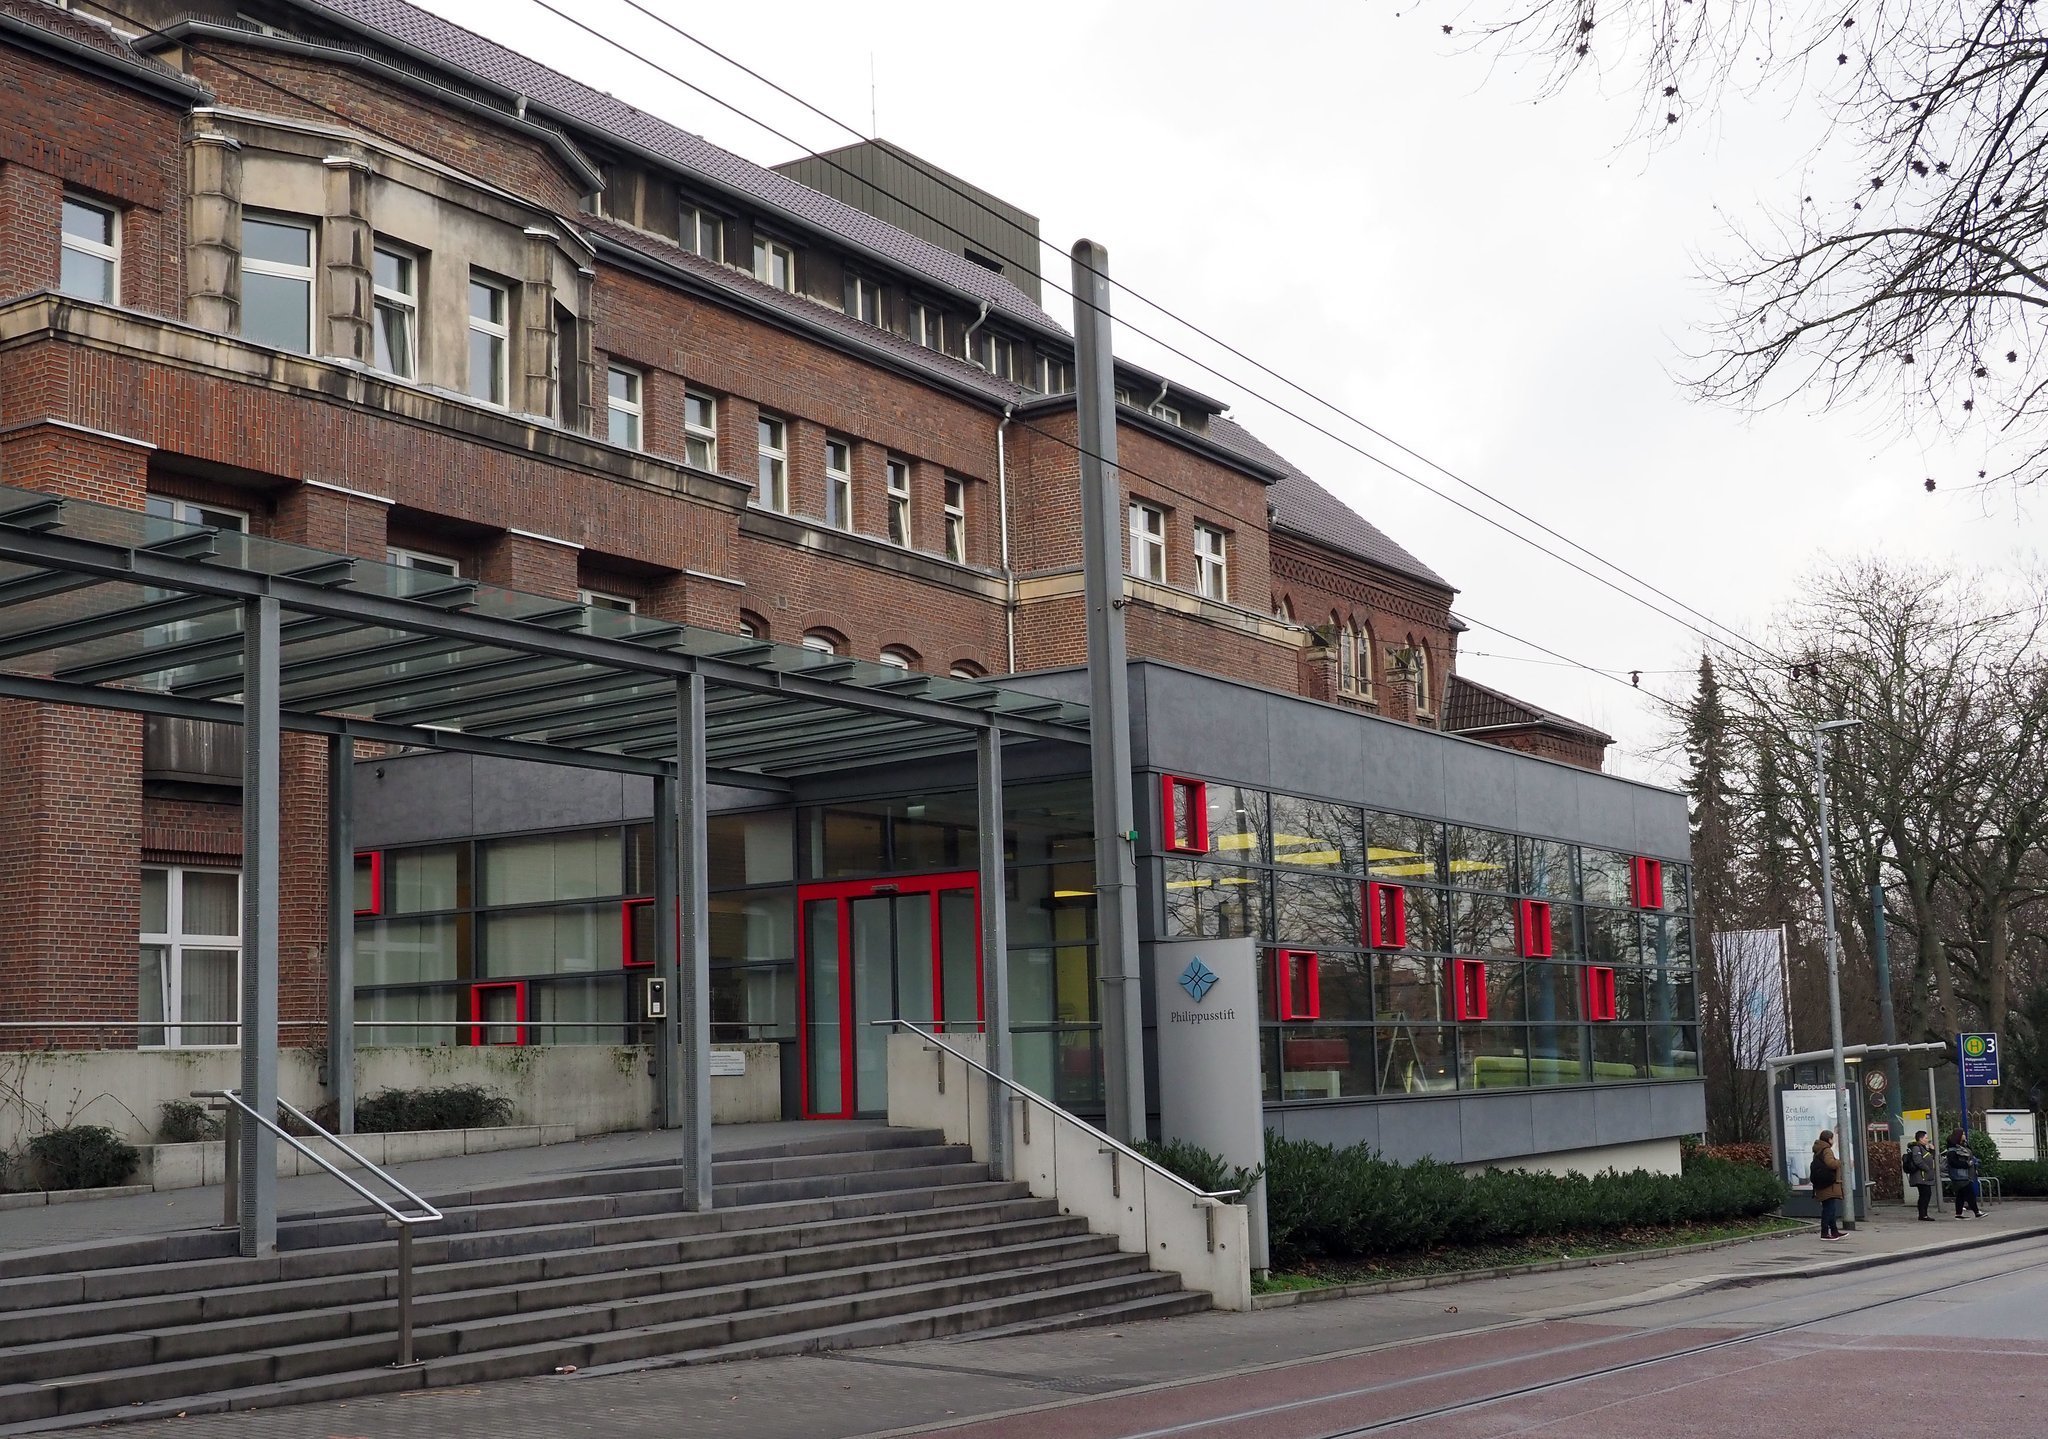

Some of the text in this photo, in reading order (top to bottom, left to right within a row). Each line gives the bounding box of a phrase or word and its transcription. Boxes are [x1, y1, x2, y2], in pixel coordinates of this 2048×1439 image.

[1171, 1008, 1235, 1024] Philippusstift
[1986, 1038, 1996, 1053] 3
[1785, 1105, 1809, 1114] Zeit für
